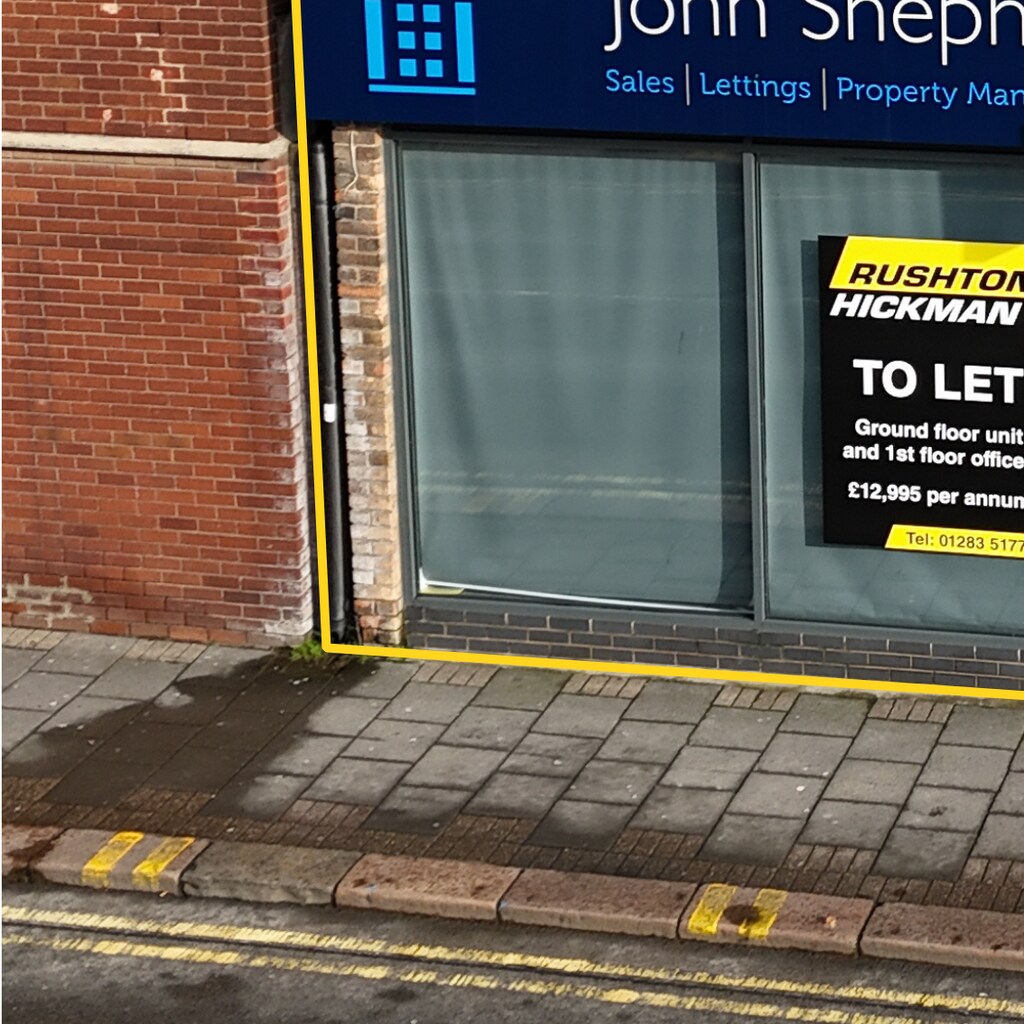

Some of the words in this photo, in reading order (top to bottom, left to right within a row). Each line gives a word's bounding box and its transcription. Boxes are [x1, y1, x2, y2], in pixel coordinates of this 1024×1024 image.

[605, 68, 676, 95] Sales
[698, 72, 812, 105] Lettings
[835, 76, 959, 111] Property
[829, 293, 1024, 326] HICKMAN
[852, 358, 918, 399] TO
[934, 363, 1024, 404] LET
[854, 418, 929, 439] Ground
[933, 423, 980, 443] floor
[986, 428, 1024, 445] unit
[842, 444, 880, 461] and
[885, 445, 915, 463] 1st
[919, 446, 966, 466] floor
[848, 482, 922, 503] £12,995
[926, 489, 959, 508] per
[906, 531, 934, 547] Tel:
[939, 534, 985, 549] 01283
